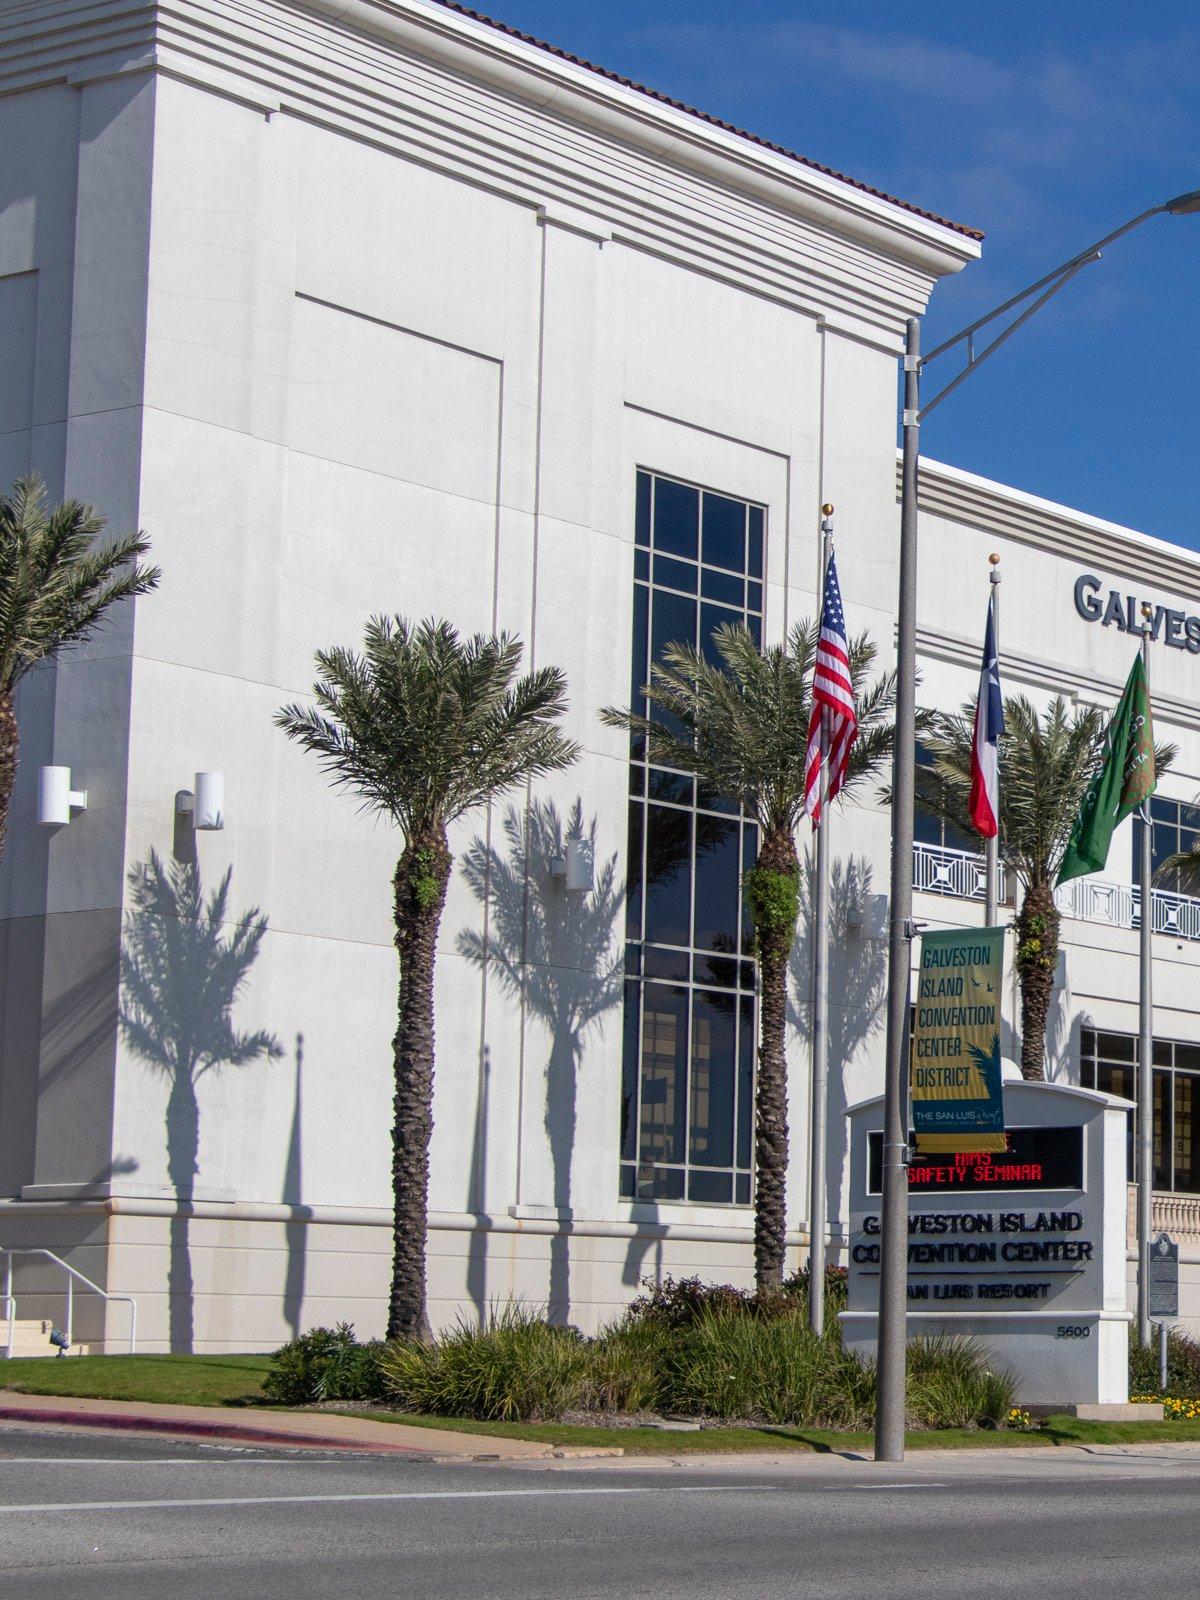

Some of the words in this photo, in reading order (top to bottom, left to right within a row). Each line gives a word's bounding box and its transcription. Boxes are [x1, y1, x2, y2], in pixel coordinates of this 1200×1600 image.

[922, 946, 991, 968] GALVESTON
[920, 977, 964, 998] ISLAND
[918, 1005, 995, 1028] CONVENTION
[917, 1037, 962, 1058] CENTER
[915, 1066, 971, 1088] DISTRICT
[916, 1112, 934, 1120] THE
[935, 1111, 955, 1120] SAN
[956, 1111, 976, 1120] LUIS
[908, 1167, 967, 1183] SAFETY
[974, 1164, 1042, 1181] SEMINAR
[863, 1213, 993, 1235] GVESTON
[1000, 1211, 1083, 1232] ISLAND
[852, 1242, 996, 1264] COVENTION
[1001, 1240, 1093, 1262] CENTER
[907, 1285, 929, 1299] AN
[933, 1285, 973, 1300] LUIS
[978, 1283, 1051, 1300] RESORT
[1057, 1326, 1090, 1337] 5600
